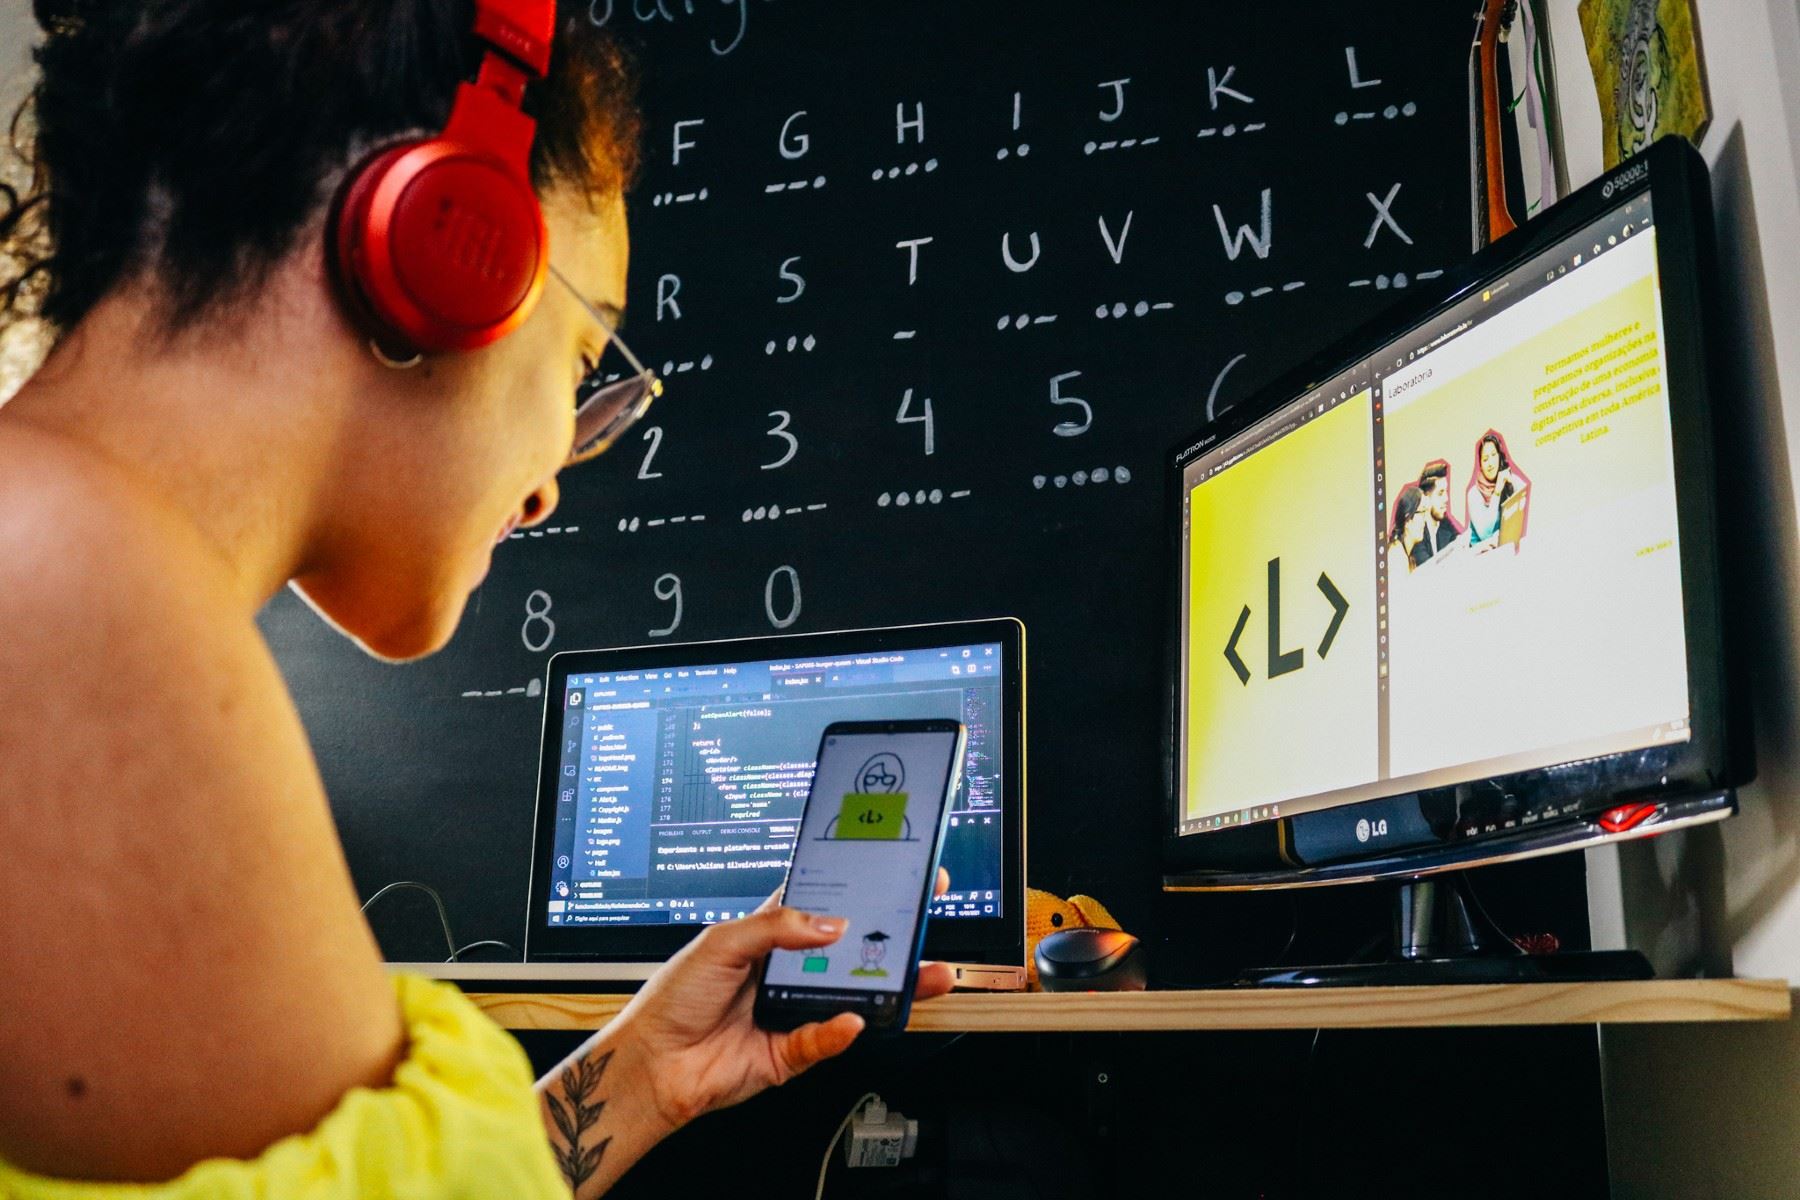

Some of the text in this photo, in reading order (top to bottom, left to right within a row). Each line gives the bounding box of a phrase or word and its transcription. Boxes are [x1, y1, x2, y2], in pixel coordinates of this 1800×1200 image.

[672, 46, 1382, 166] F G H I J K L
[656, 182, 1414, 322] R S T U V W X
[1591, 324, 1632, 352] mulheres
[1533, 367, 1583, 399] preparamos
[1580, 380, 1591, 391] de
[1592, 371, 1612, 386] uma
[637, 370, 1093, 480] 2 3 4 5
[1531, 411, 1557, 432] digital
[1557, 404, 1579, 419] mais
[1536, 418, 1584, 448] competitiva
[1585, 411, 1599, 424] em
[1600, 402, 1620, 417] toda
[521, 565, 802, 653] 8 9 0
[1371, 819, 1388, 837] LG
